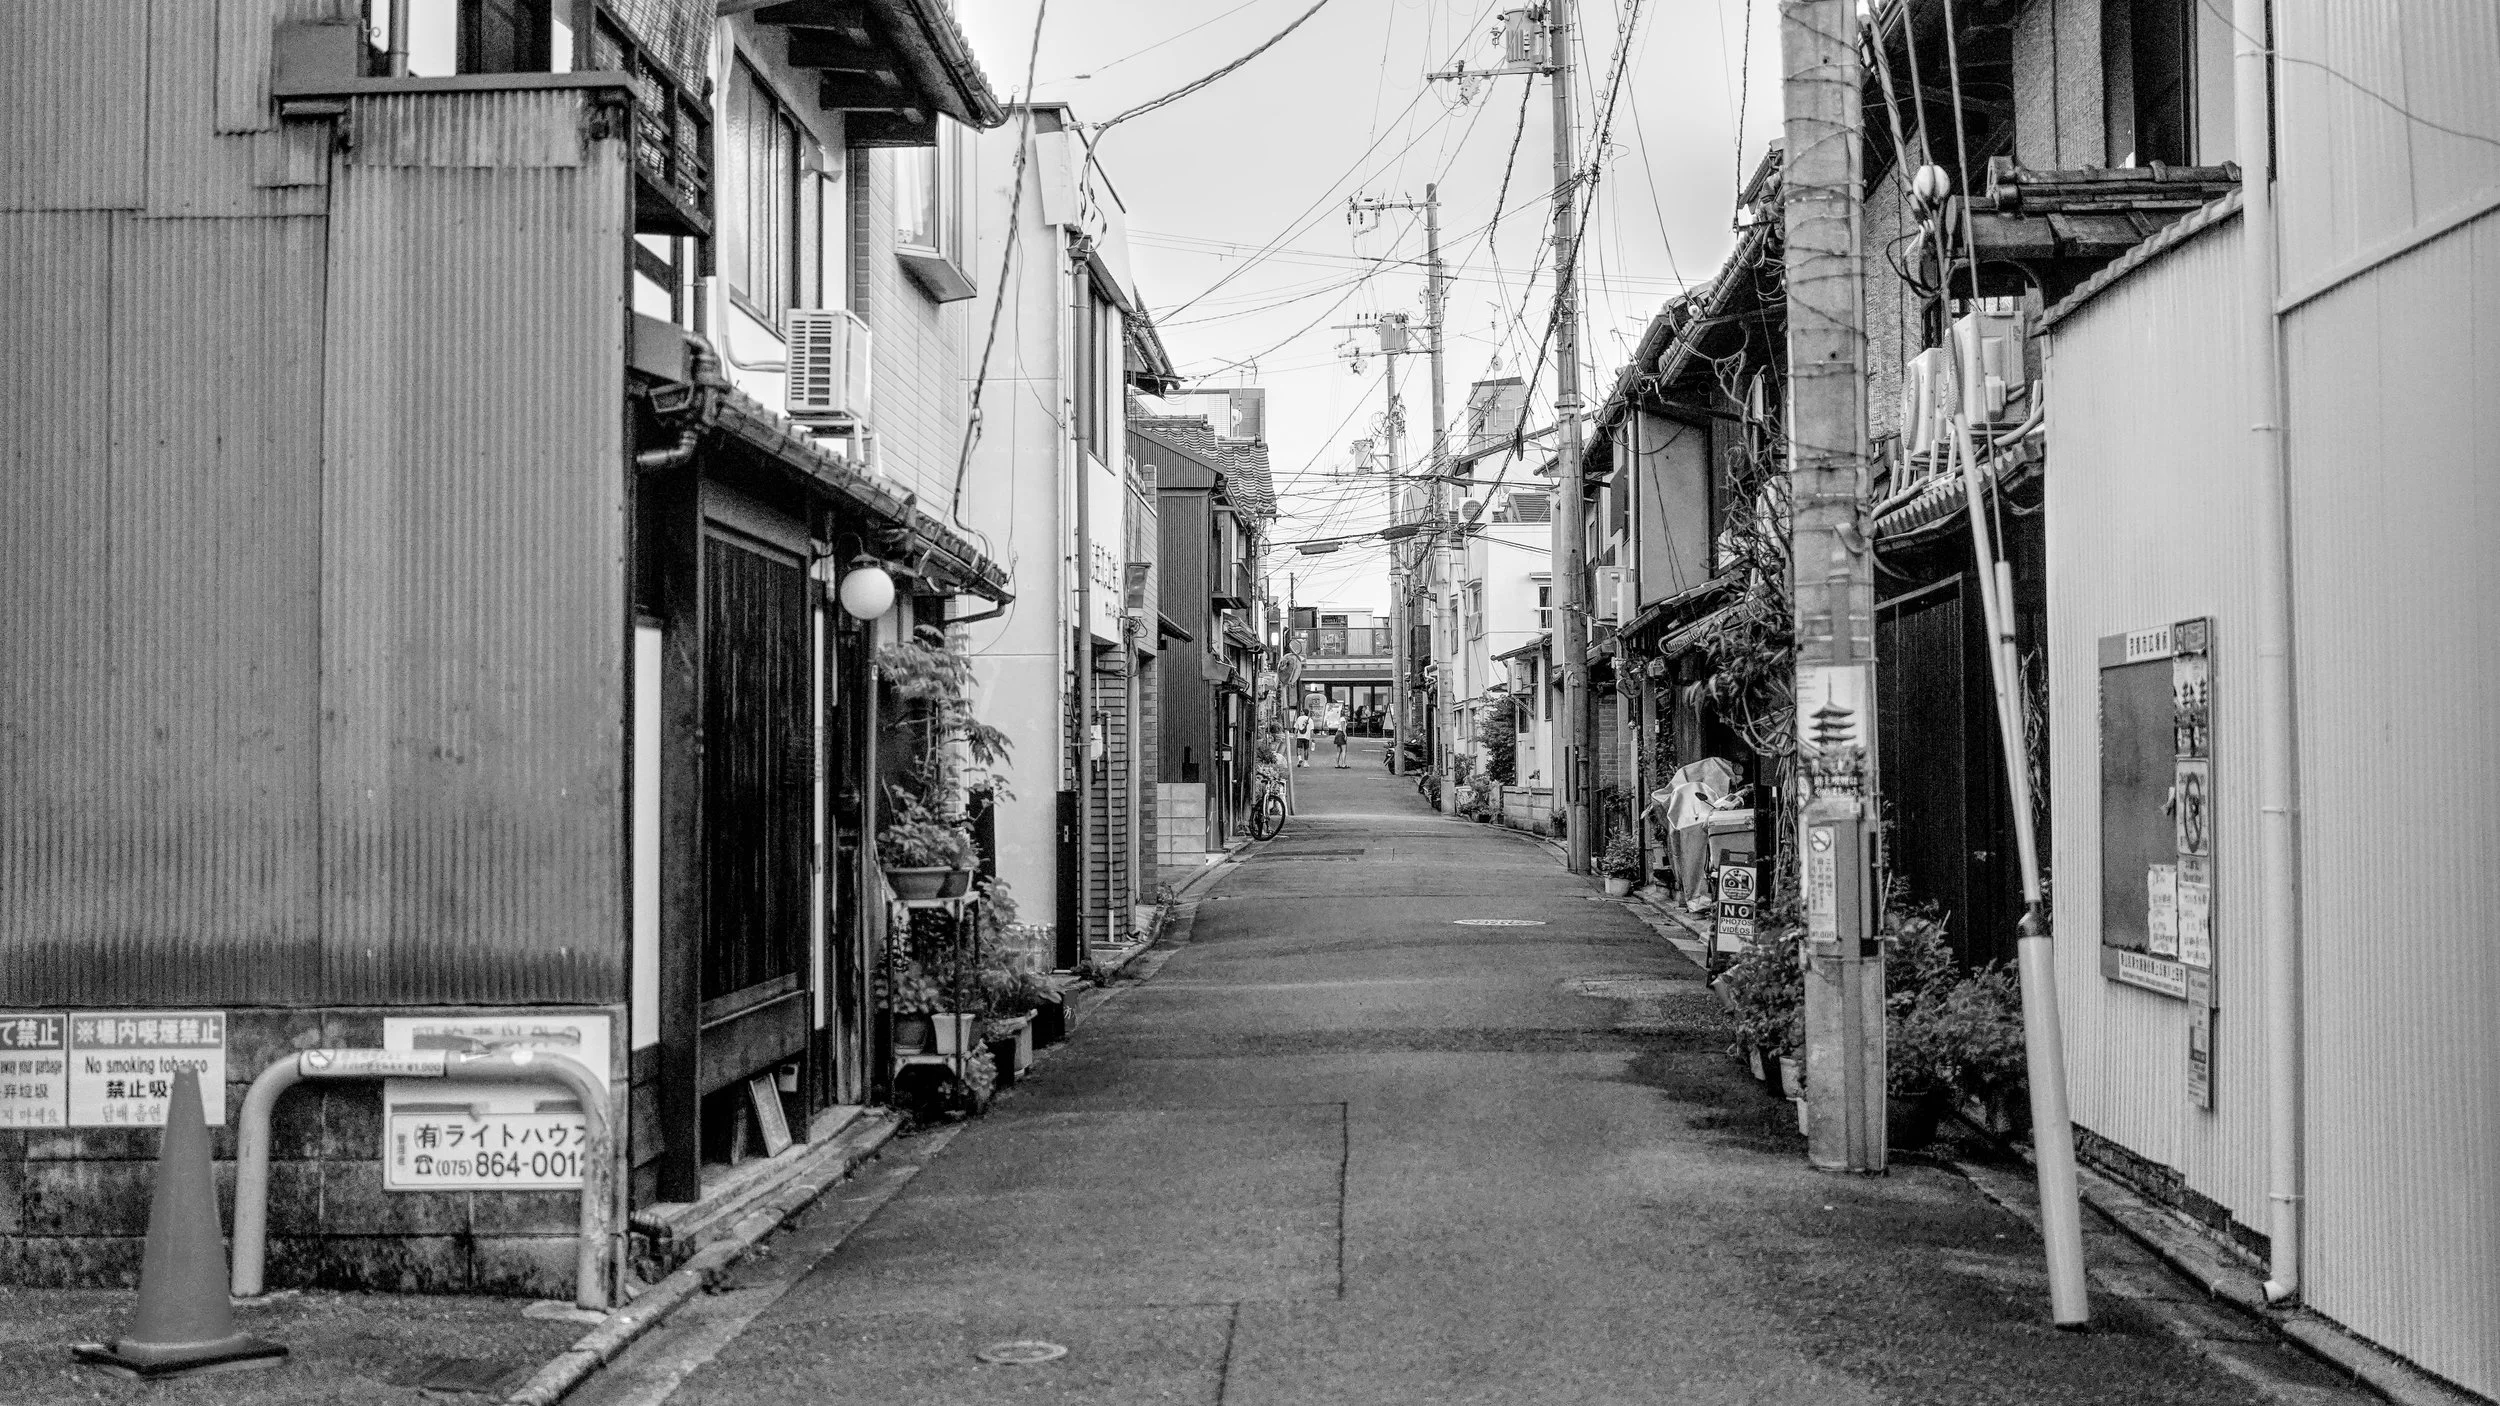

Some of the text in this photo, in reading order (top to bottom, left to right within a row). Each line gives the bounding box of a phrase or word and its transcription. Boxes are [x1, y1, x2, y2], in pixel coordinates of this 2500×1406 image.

[1724, 904, 1750, 918] NO
[85, 1056, 102, 1074] No
[106, 1056, 155, 1075] smoking
[0, 1083, 48, 1098] 弃垃圾
[106, 1080, 173, 1098] 禁止吸
